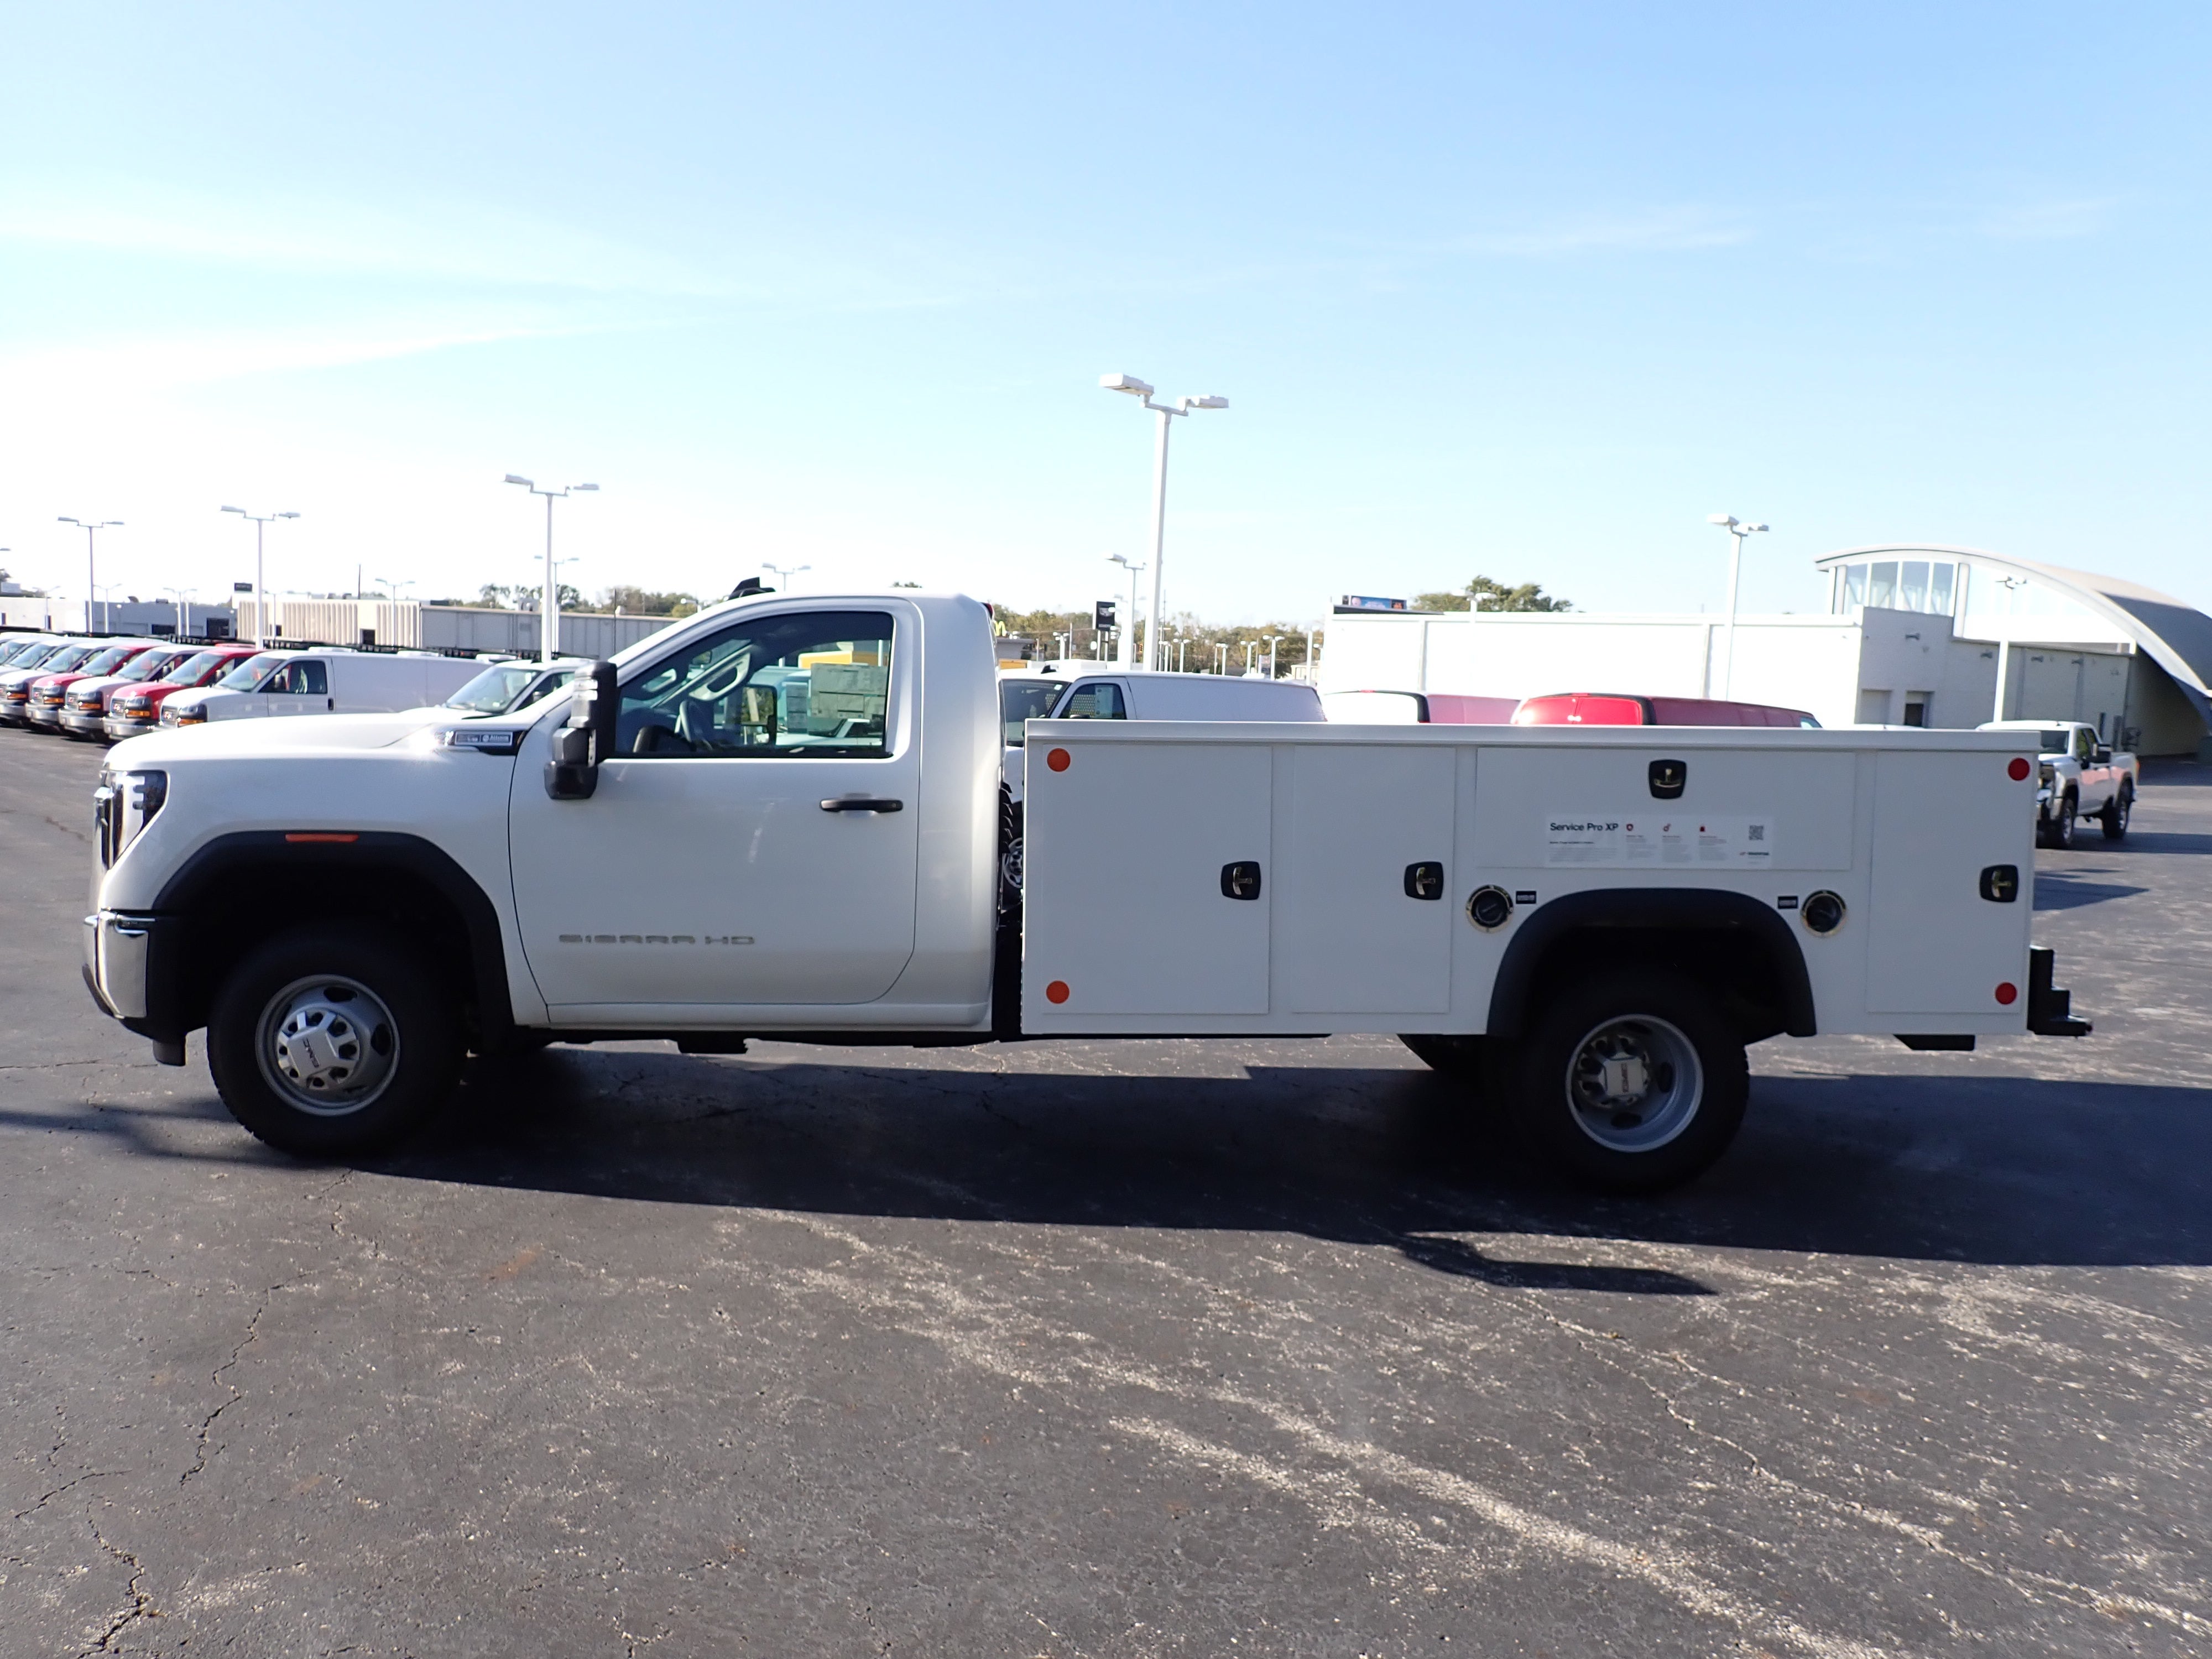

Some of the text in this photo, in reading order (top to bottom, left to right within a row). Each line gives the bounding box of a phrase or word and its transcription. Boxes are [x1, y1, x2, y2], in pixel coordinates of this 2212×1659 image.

[559, 934, 755, 945] SIERRA HD
[302, 1037, 319, 1068] GMC
